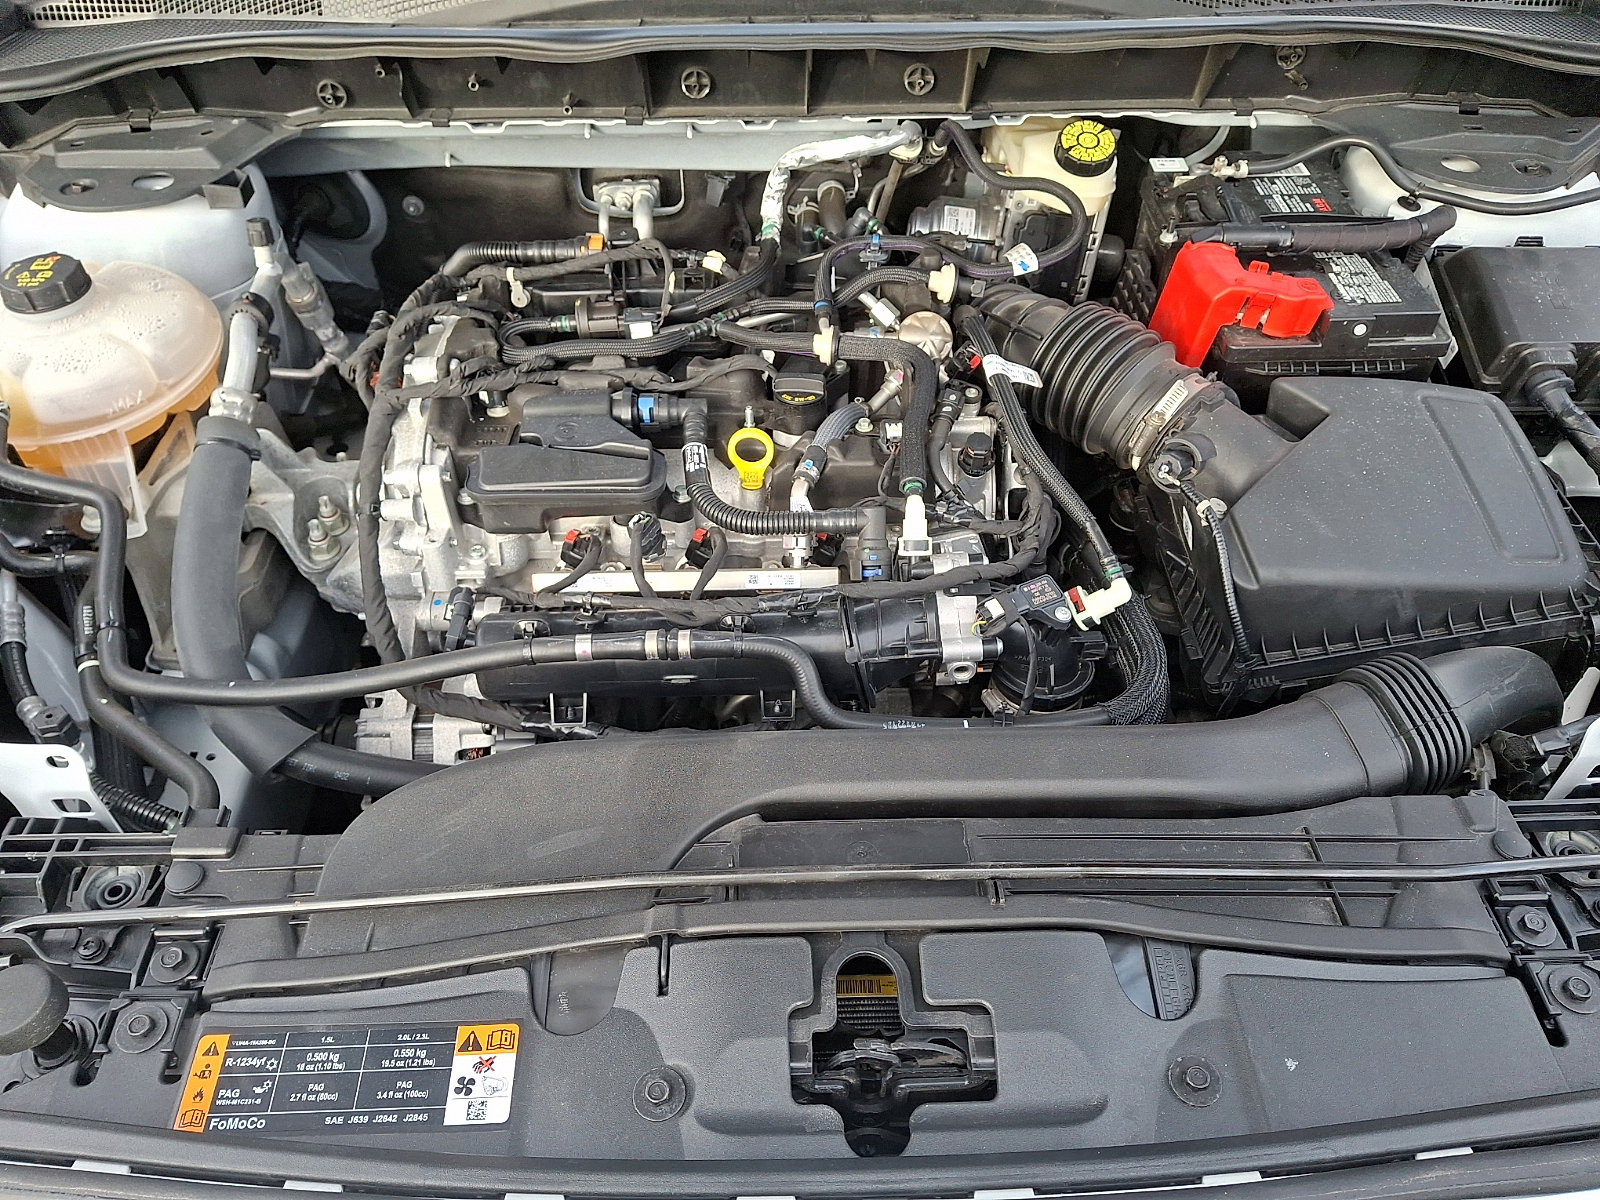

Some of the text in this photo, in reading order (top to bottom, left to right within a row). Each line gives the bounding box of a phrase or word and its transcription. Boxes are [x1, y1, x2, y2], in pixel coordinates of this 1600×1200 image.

[306, 1052, 340, 1062] 0.500 kg
[393, 1048, 427, 1058] 0.550 kg
[225, 1056, 267, 1068] R-1234yf
[315, 1062, 331, 1072] (1.10
[332, 1062, 346, 1071] lbs)
[381, 1059, 395, 1068] 19.5
[405, 1058, 421, 1068] (1.21
[422, 1058, 436, 1067] lbs)
[308, 1083, 325, 1091] PAG
[396, 1081, 413, 1089] PAG
[218, 1089, 240, 1098] PAG
[289, 1094, 301, 1102] 2.7
[376, 1091, 387, 1099] 3.4
[404, 1090, 429, 1099] (100cc)
[209, 1117, 266, 1130] FoMoCo
[324, 1113, 429, 1125] SAE J639 J2842 J2845
